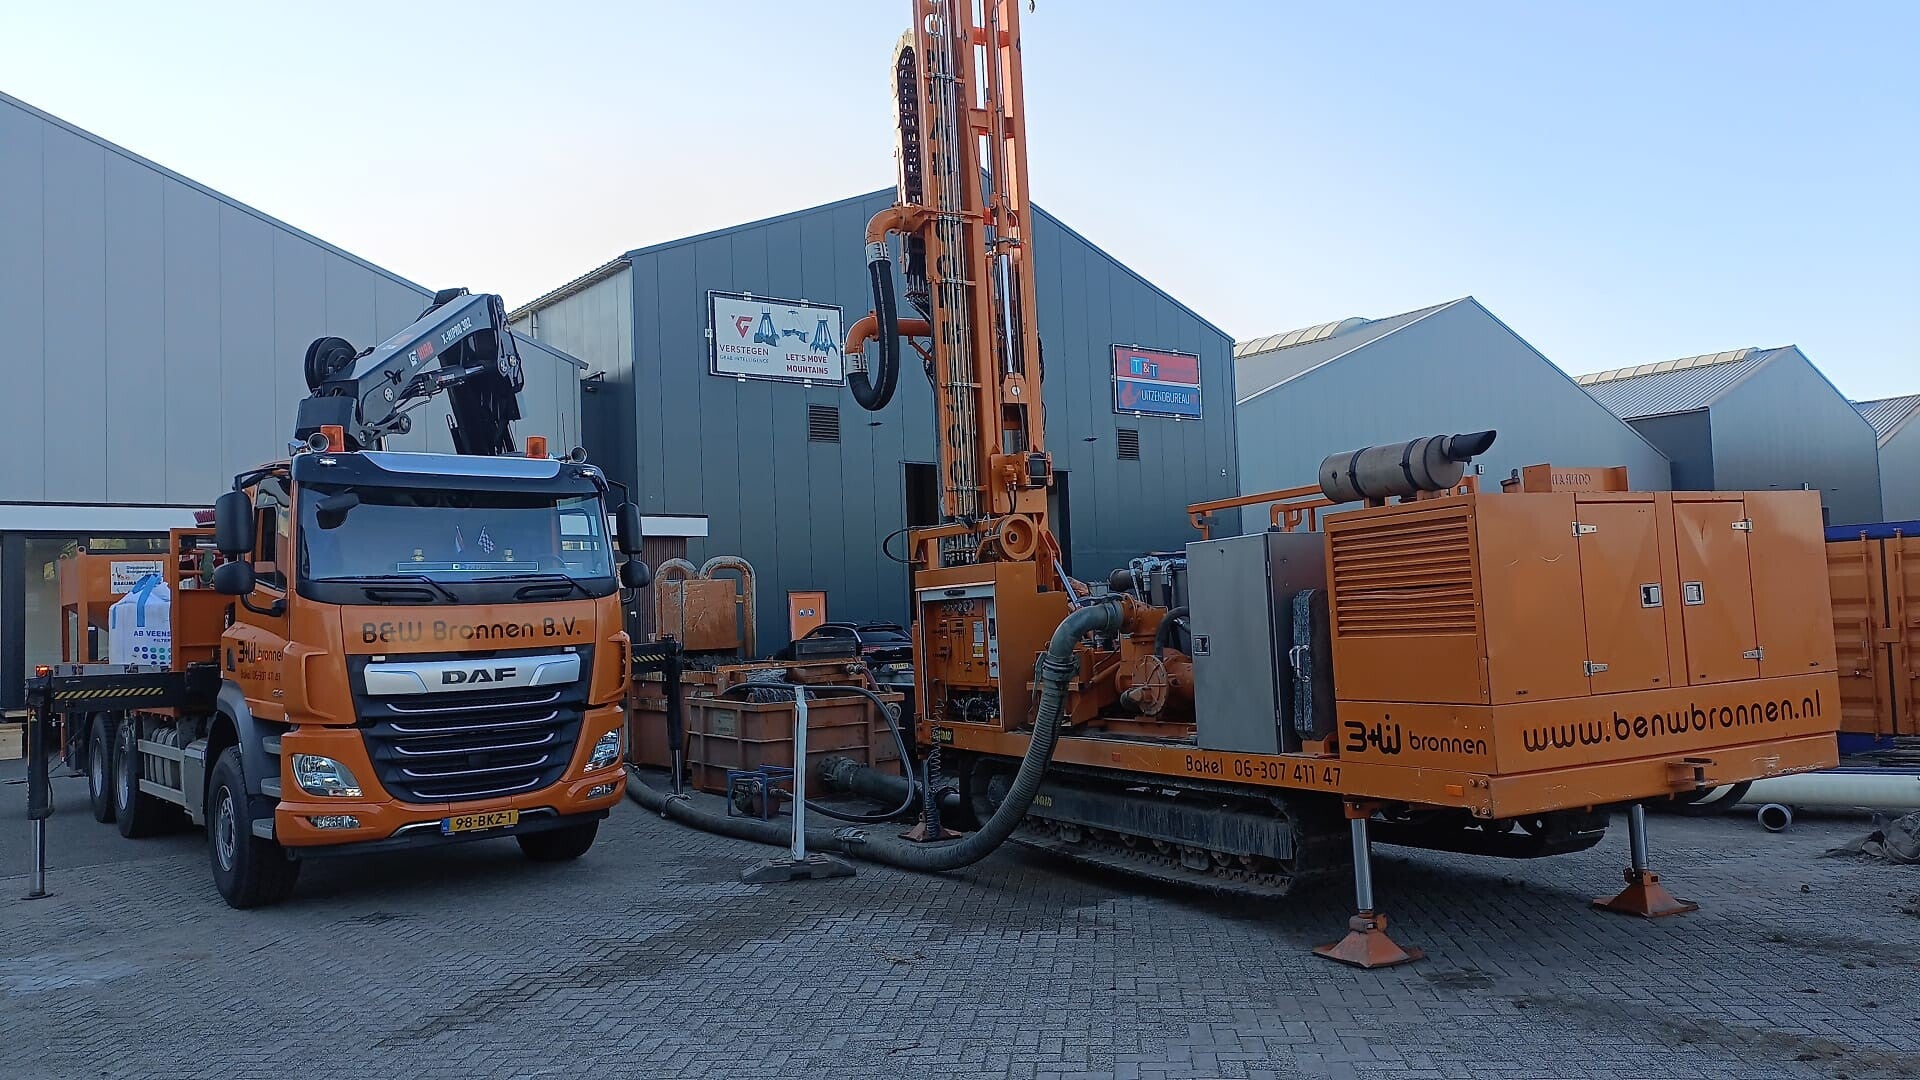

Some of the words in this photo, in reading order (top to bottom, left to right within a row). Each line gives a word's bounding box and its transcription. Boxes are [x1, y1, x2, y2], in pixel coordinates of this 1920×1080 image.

[719, 344, 769, 356] VERSTEGEN
[785, 353, 806, 362] LET'S
[808, 355, 827, 364] MOVE
[786, 365, 829, 375] MOUNTAINS
[1141, 389, 1190, 405] UITZENDBUREAU
[362, 621, 422, 644] B&W
[433, 620, 534, 641] Bronnen
[543, 616, 581, 637] B.V.
[441, 667, 516, 684] DAF
[1523, 690, 1821, 753] www.benwbronnen.nl
[1409, 731, 1487, 755] bronnen
[1186, 756, 1224, 776] Bakel
[1234, 761, 1286, 781] 06-307
[1293, 764, 1315, 784] 411
[1323, 767, 1341, 787] 47
[455, 812, 512, 830] 98-BKZ-1
